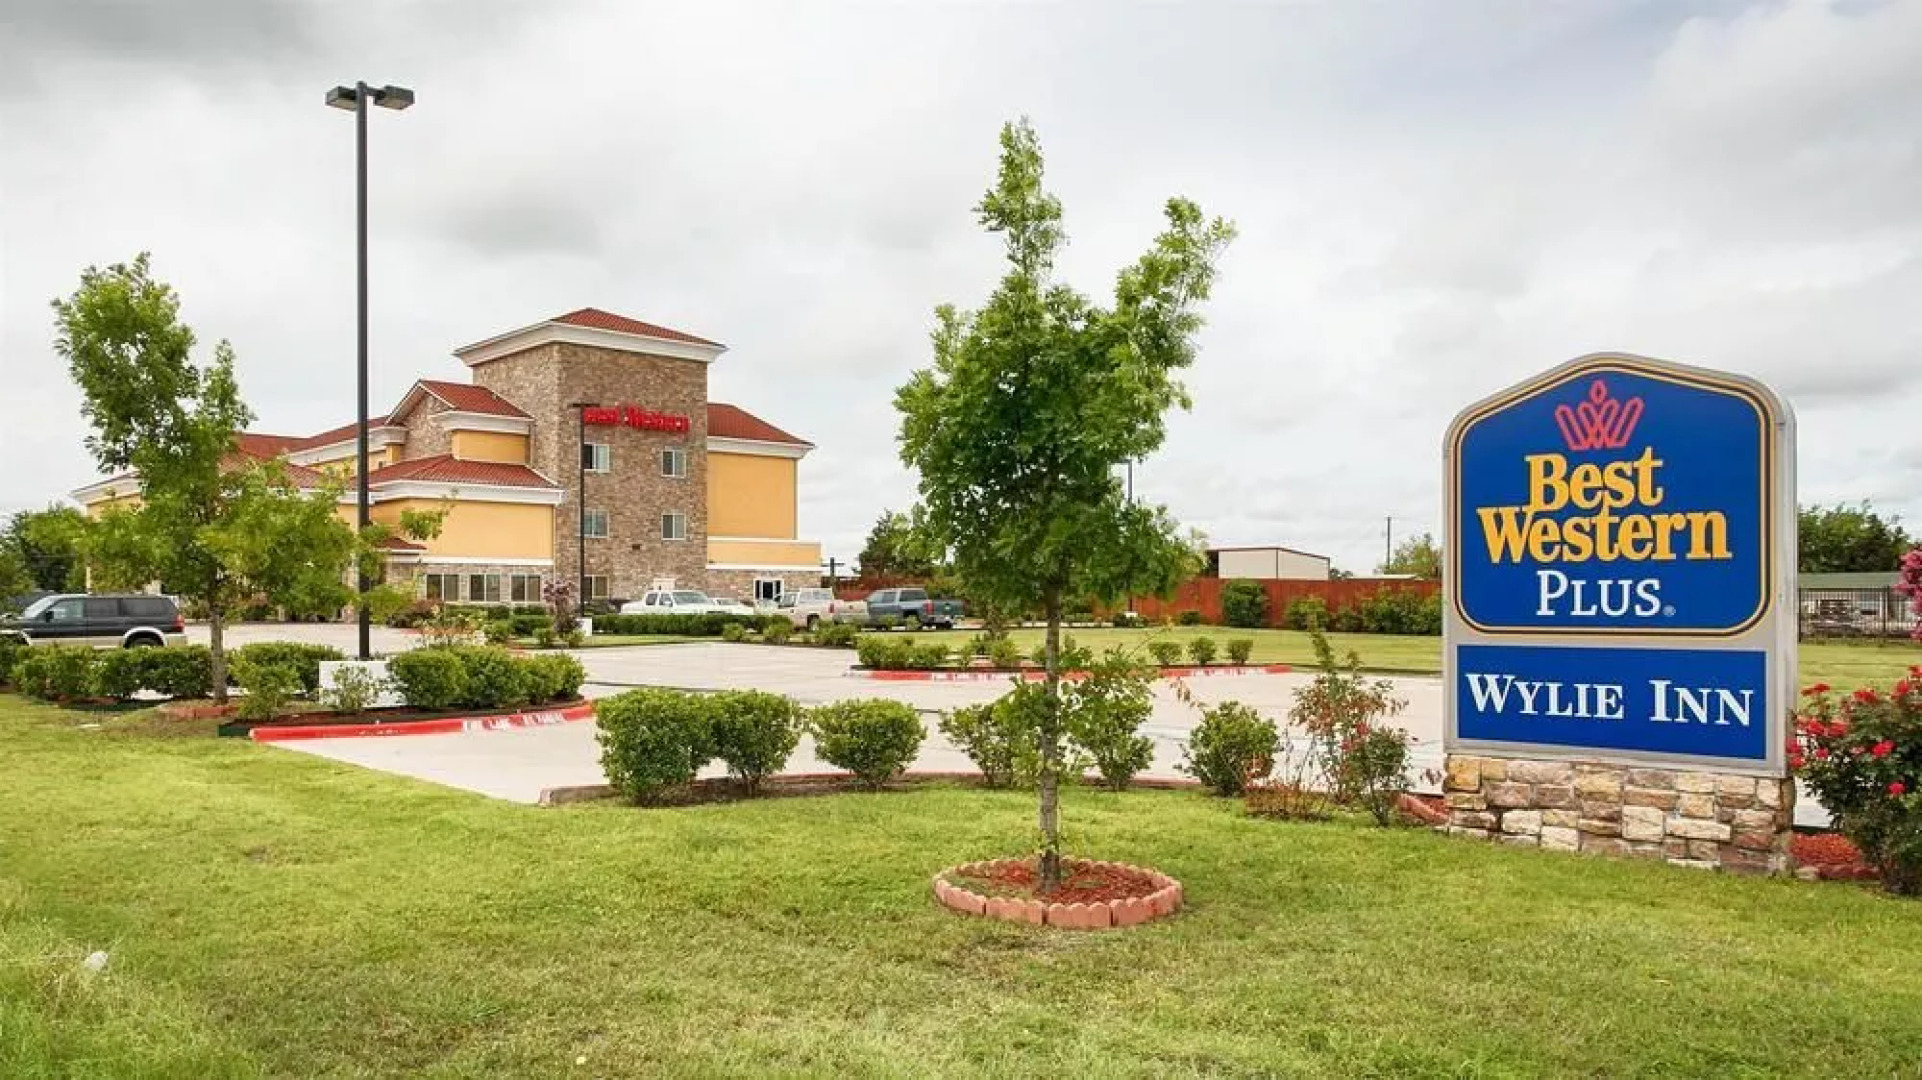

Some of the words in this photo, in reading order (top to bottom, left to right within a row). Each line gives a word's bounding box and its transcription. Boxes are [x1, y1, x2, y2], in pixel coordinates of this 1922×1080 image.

[1524, 446, 1665, 512] Best
[1476, 490, 1733, 564] Western
[1536, 570, 1662, 617] PLUS
[1465, 672, 1625, 720] WYLIE
[1649, 679, 1754, 727] INN
